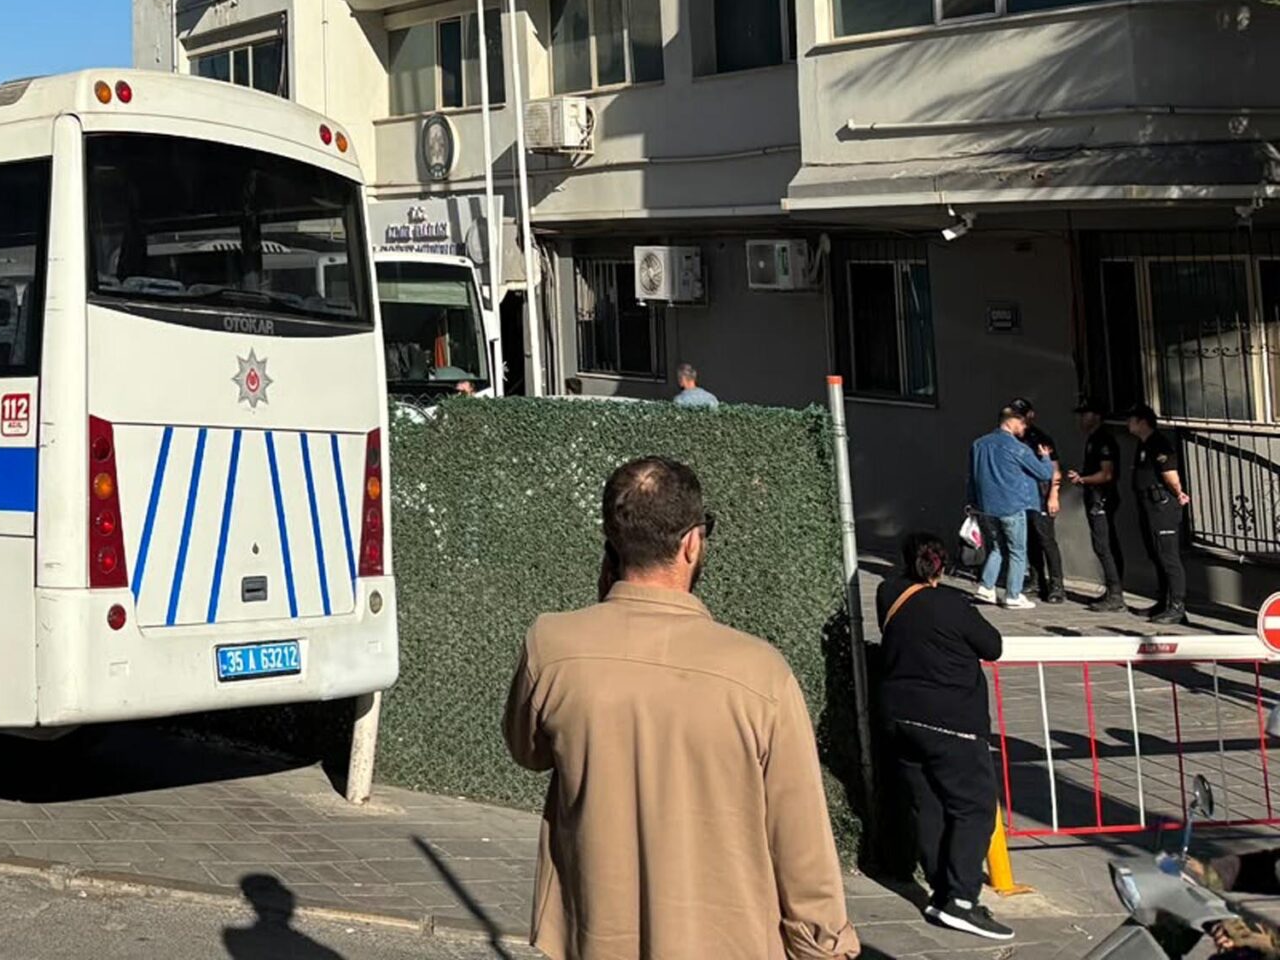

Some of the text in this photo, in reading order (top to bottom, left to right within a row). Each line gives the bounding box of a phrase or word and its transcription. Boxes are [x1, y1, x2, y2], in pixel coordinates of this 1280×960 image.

[223, 316, 274, 335] OTOKAR
[3, 398, 28, 419] 112
[227, 646, 298, 672] 35 A 63212
